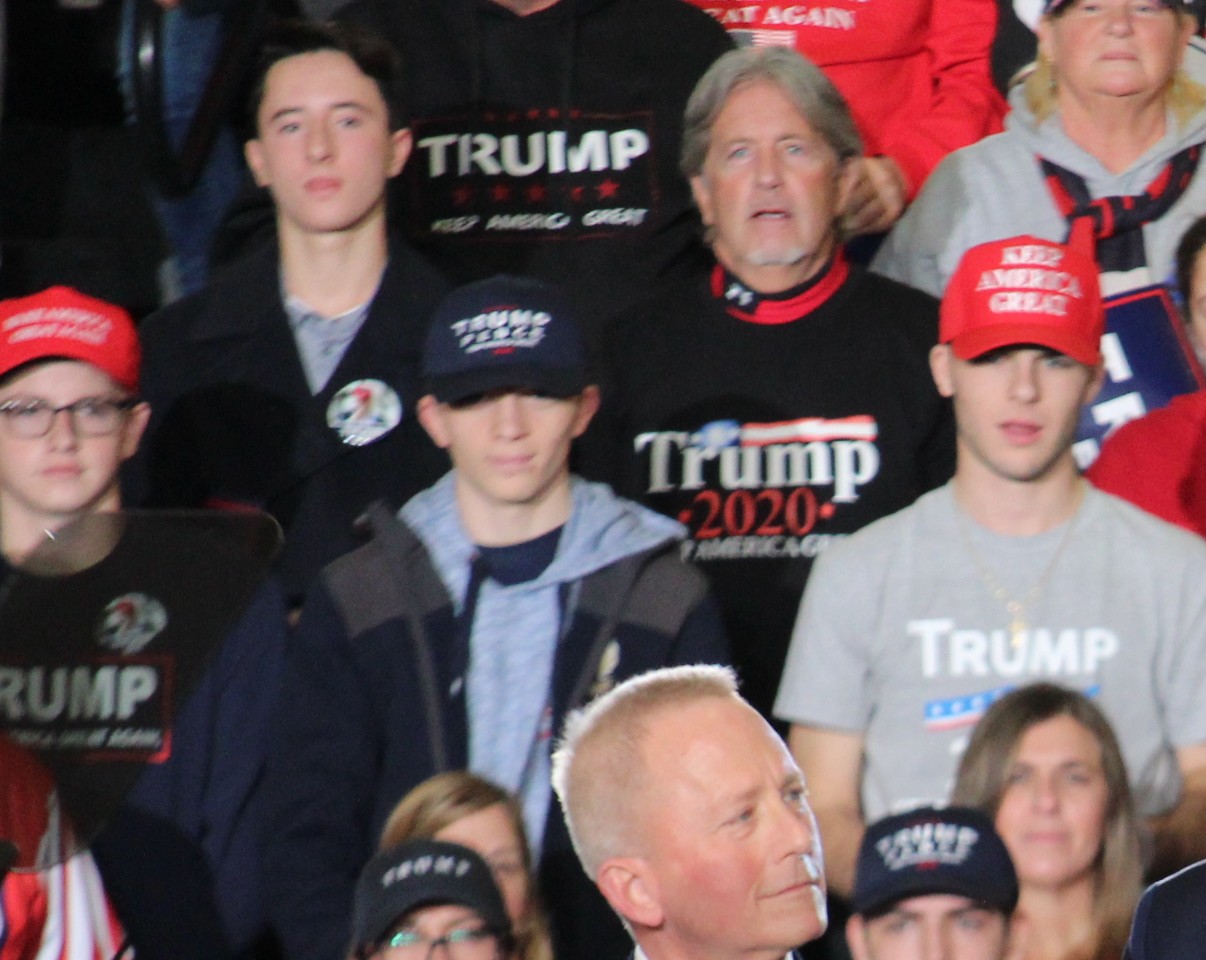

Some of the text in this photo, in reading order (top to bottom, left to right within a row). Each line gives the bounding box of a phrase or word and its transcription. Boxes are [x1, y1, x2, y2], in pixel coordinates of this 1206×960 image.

[762, 6, 856, 30] AGAIN
[417, 128, 649, 178] TRUMP
[1001, 244, 1063, 268] KEEP
[975, 267, 1083, 299] AMERICA
[988, 291, 1068, 316] GREAT
[450, 308, 551, 337] TRUMP
[634, 430, 880, 503] Trump
[694, 488, 818, 538] 2020
[906, 617, 1120, 678] TRUMP
